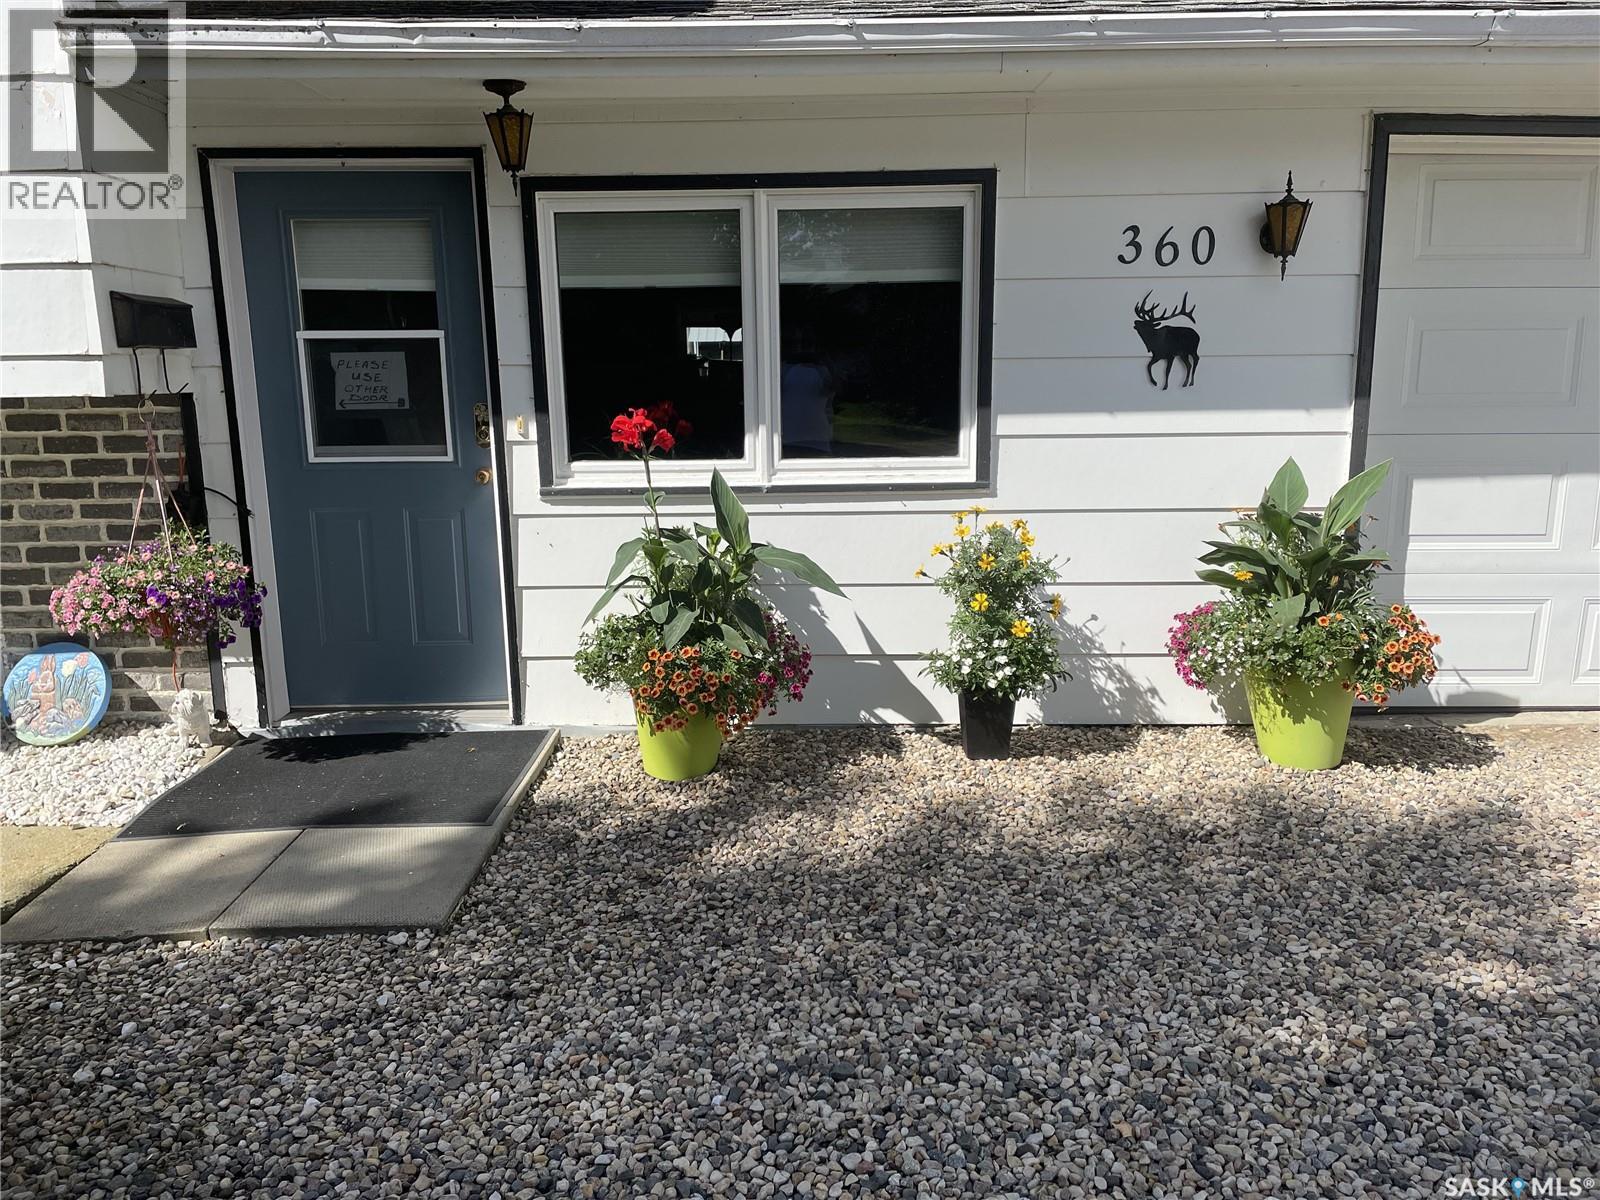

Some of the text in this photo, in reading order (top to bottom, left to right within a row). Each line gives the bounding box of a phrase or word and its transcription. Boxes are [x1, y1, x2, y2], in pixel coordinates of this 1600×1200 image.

[1117, 224, 1216, 267] 360
[337, 359, 389, 370] PLEASE
[351, 372, 383, 383] USE
[344, 384, 389, 394] OTHER
[349, 394, 389, 402] DOOR
